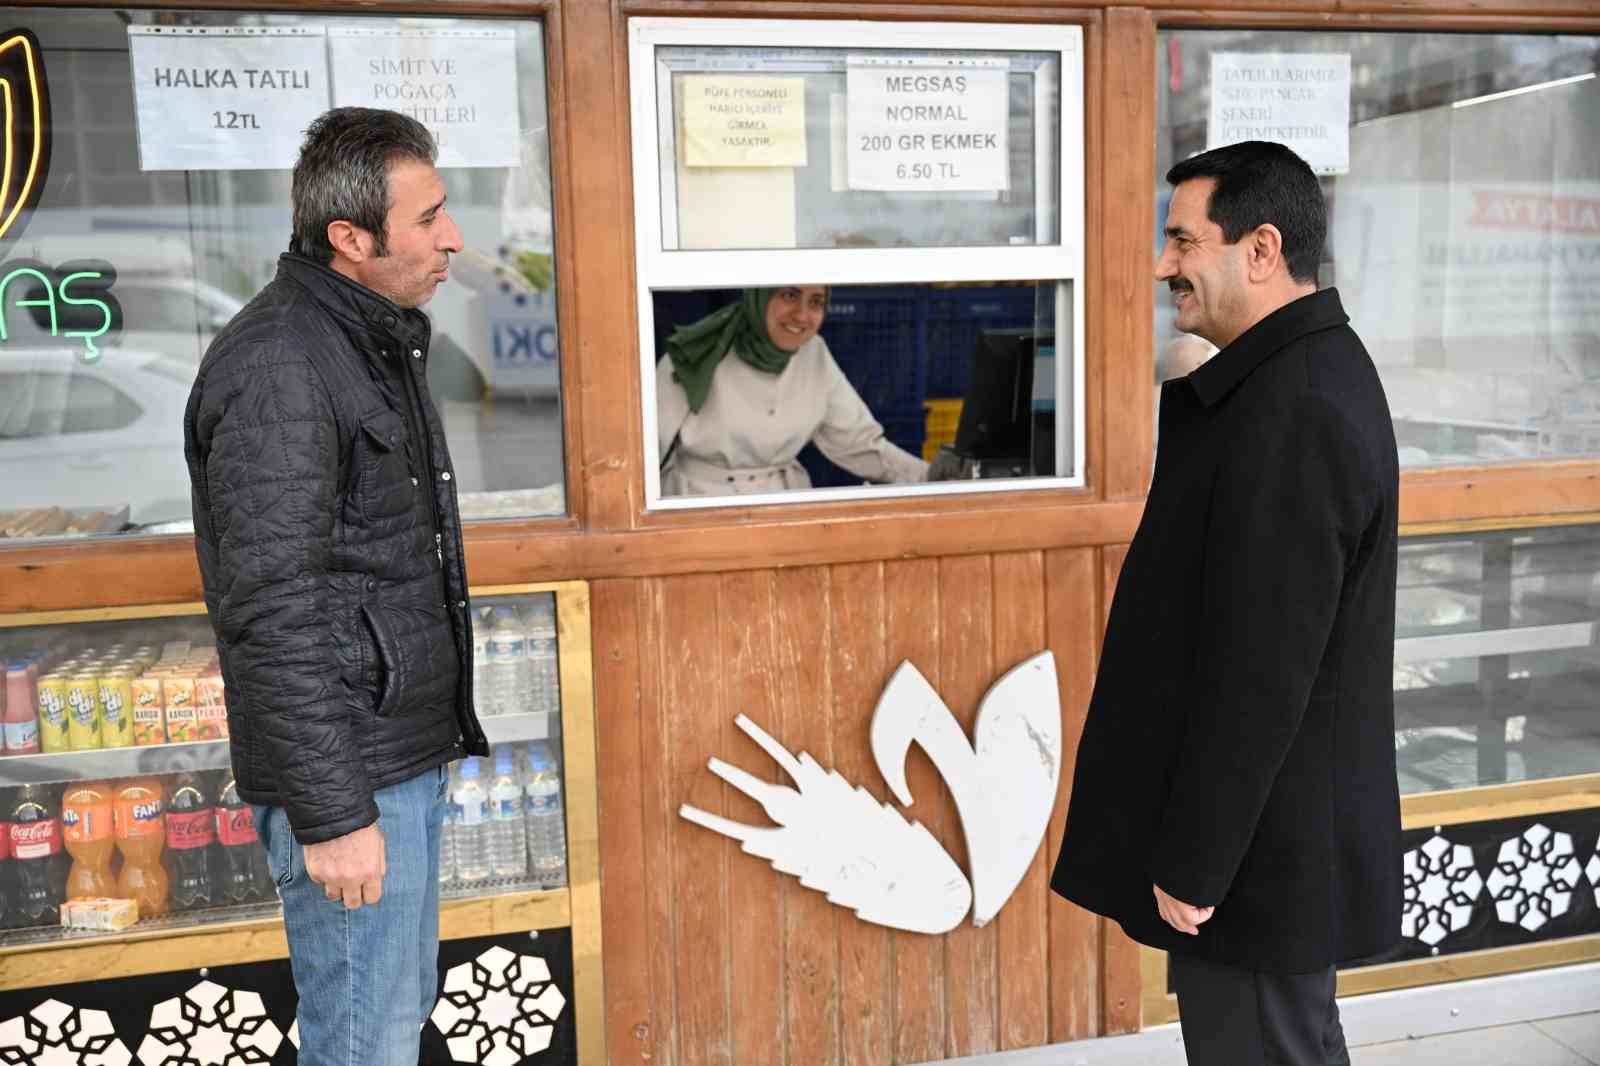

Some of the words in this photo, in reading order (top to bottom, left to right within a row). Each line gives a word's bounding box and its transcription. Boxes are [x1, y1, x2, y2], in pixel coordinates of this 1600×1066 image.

[369, 57, 423, 76] SİMİT
[430, 58, 457, 75] VE
[154, 67, 238, 89] HALKA
[244, 69, 310, 90] TATLI
[886, 76, 967, 95] MEGSAŞ
[374, 78, 457, 101] POĞAÇA
[212, 111, 261, 129] 12TL
[401, 103, 477, 122] İTLERİ
[887, 105, 968, 121] NORMAL
[861, 135, 892, 151] 200
[898, 135, 926, 151] GR
[931, 134, 997, 150] EKMEK
[896, 163, 933, 179] 6.50
[938, 163, 960, 178] TL
[133, 799, 161, 818] FAN
